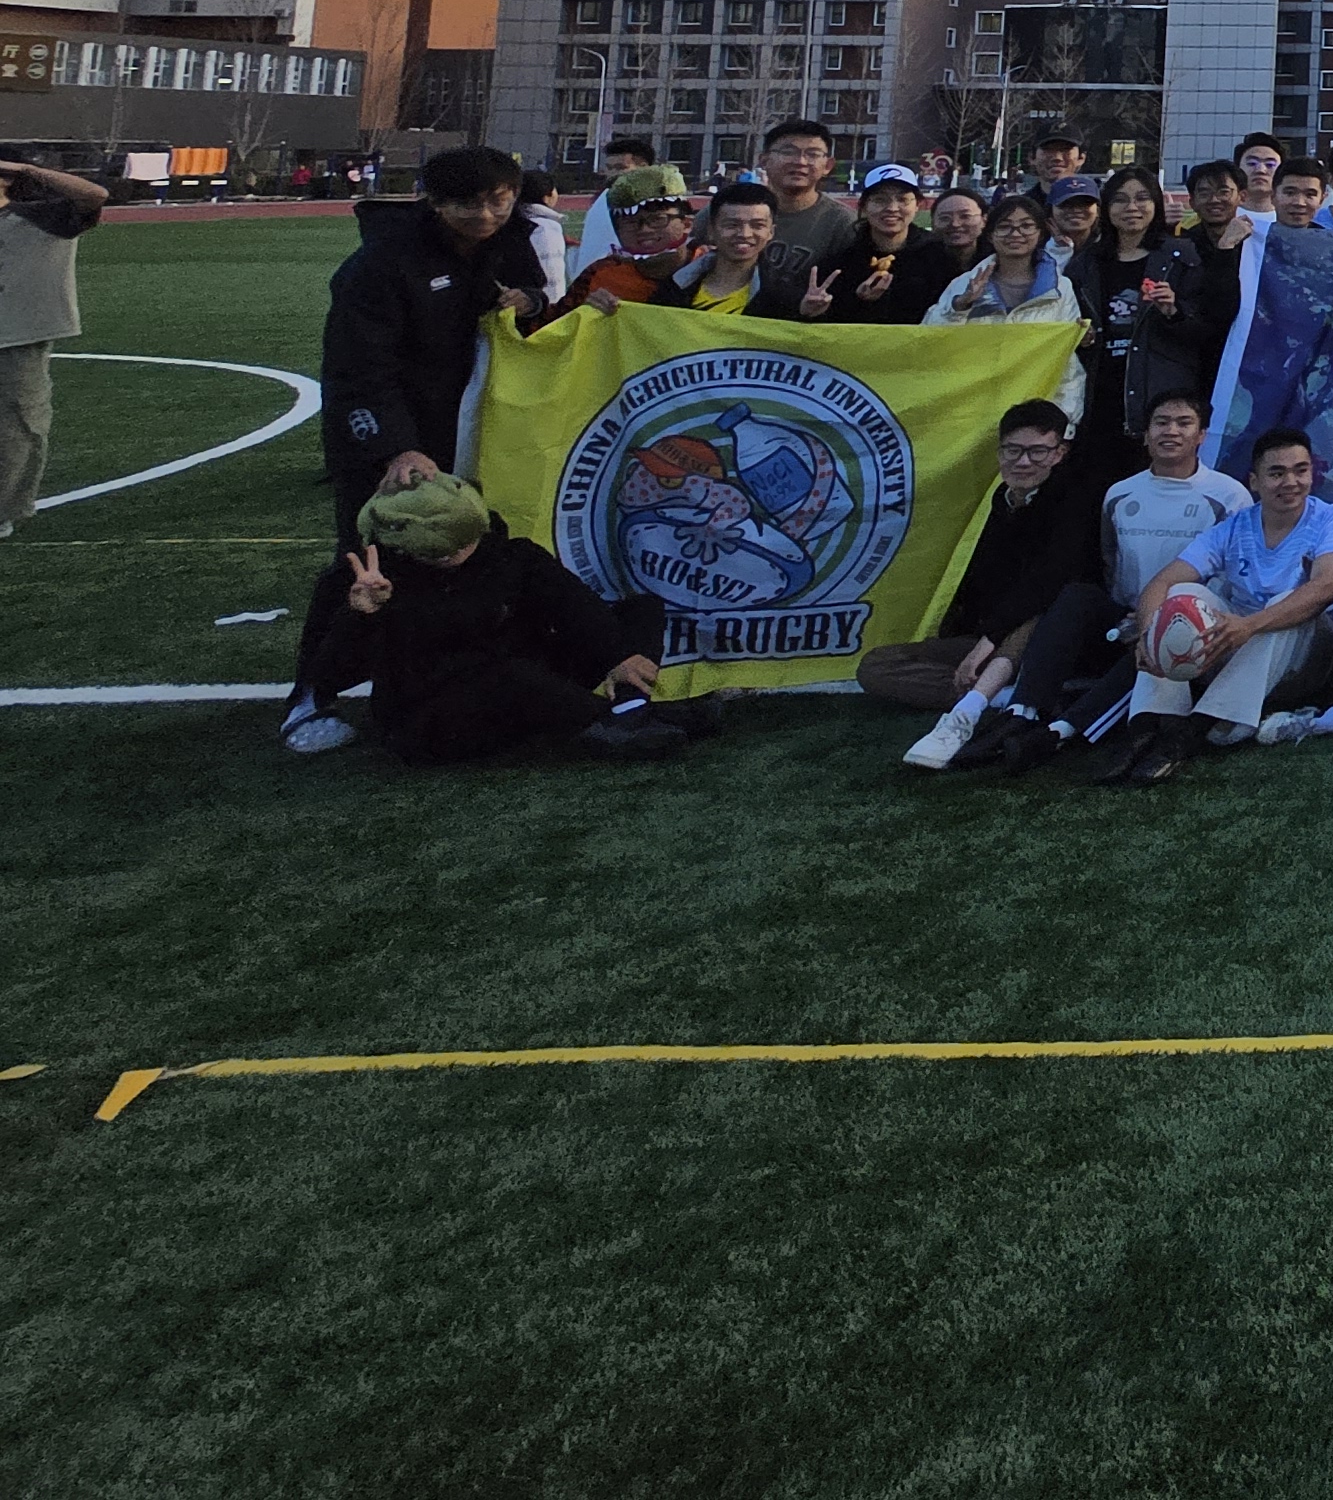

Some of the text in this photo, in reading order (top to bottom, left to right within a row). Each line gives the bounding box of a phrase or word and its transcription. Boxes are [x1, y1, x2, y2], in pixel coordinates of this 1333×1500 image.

[561, 358, 906, 516] CHINA AGRICULTURAL UNIVERSITY
[750, 457, 793, 497] NaCl
[1184, 504, 1199, 518] 01
[641, 550, 757, 603] BIO&SCI
[1239, 558, 1249, 577] 2
[715, 610, 862, 654] RUGBY
